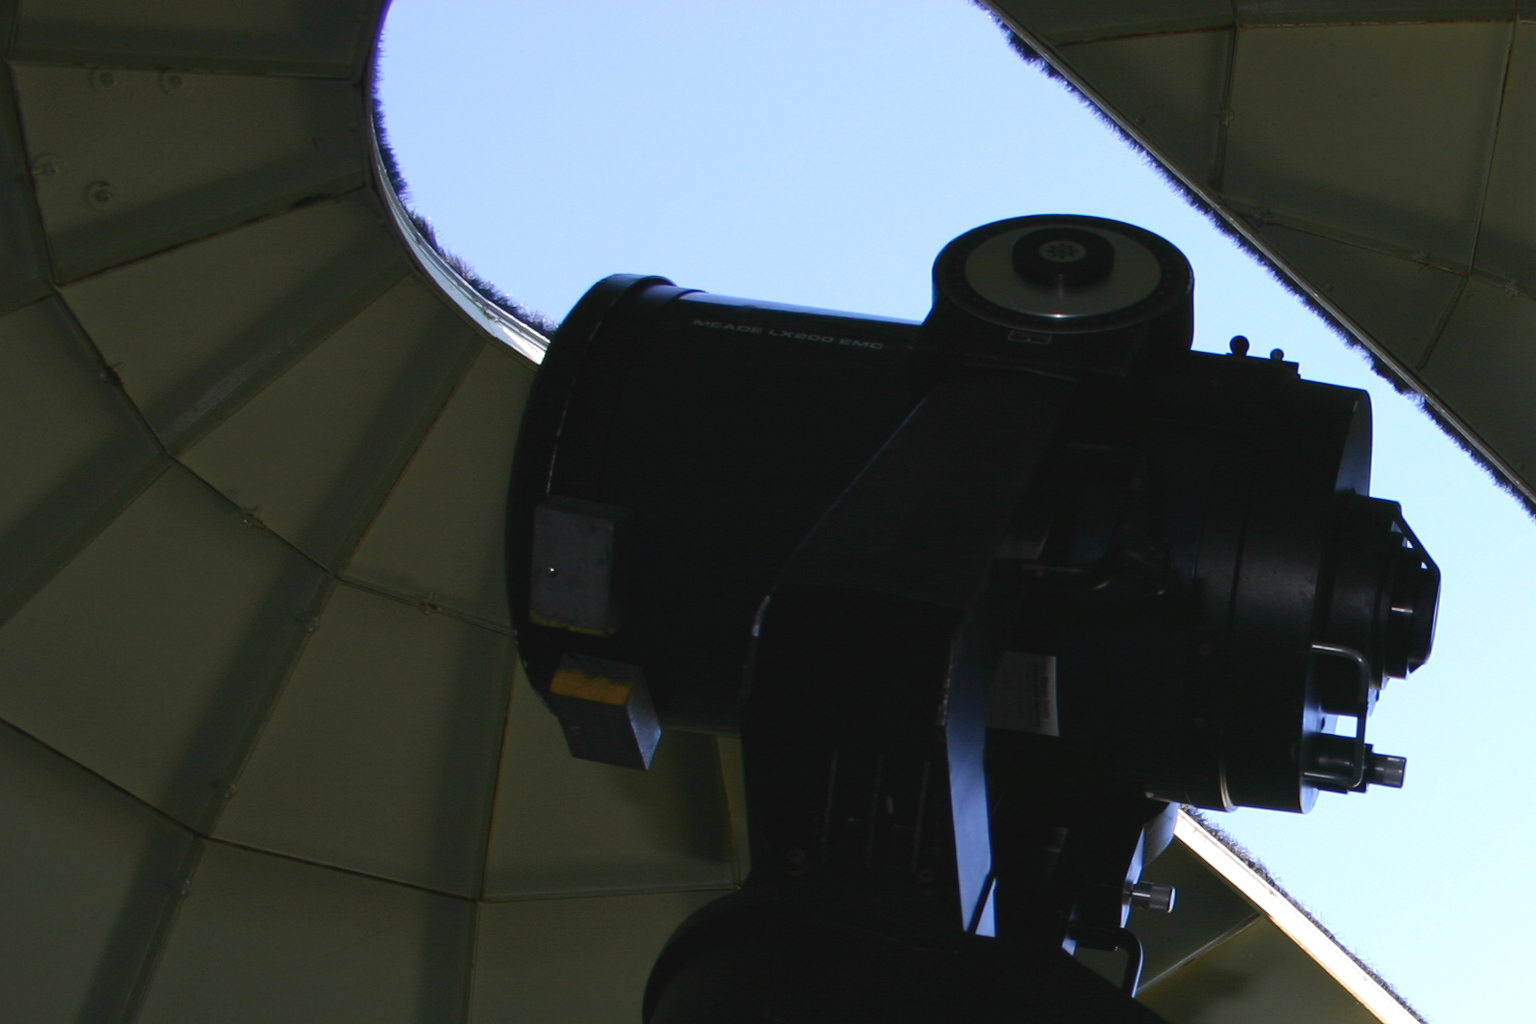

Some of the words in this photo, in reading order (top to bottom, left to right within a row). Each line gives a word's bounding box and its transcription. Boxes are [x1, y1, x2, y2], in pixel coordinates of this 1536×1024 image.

[693, 319, 762, 333] MEADE
[768, 328, 834, 342] LX200
[839, 338, 885, 350] EMC
